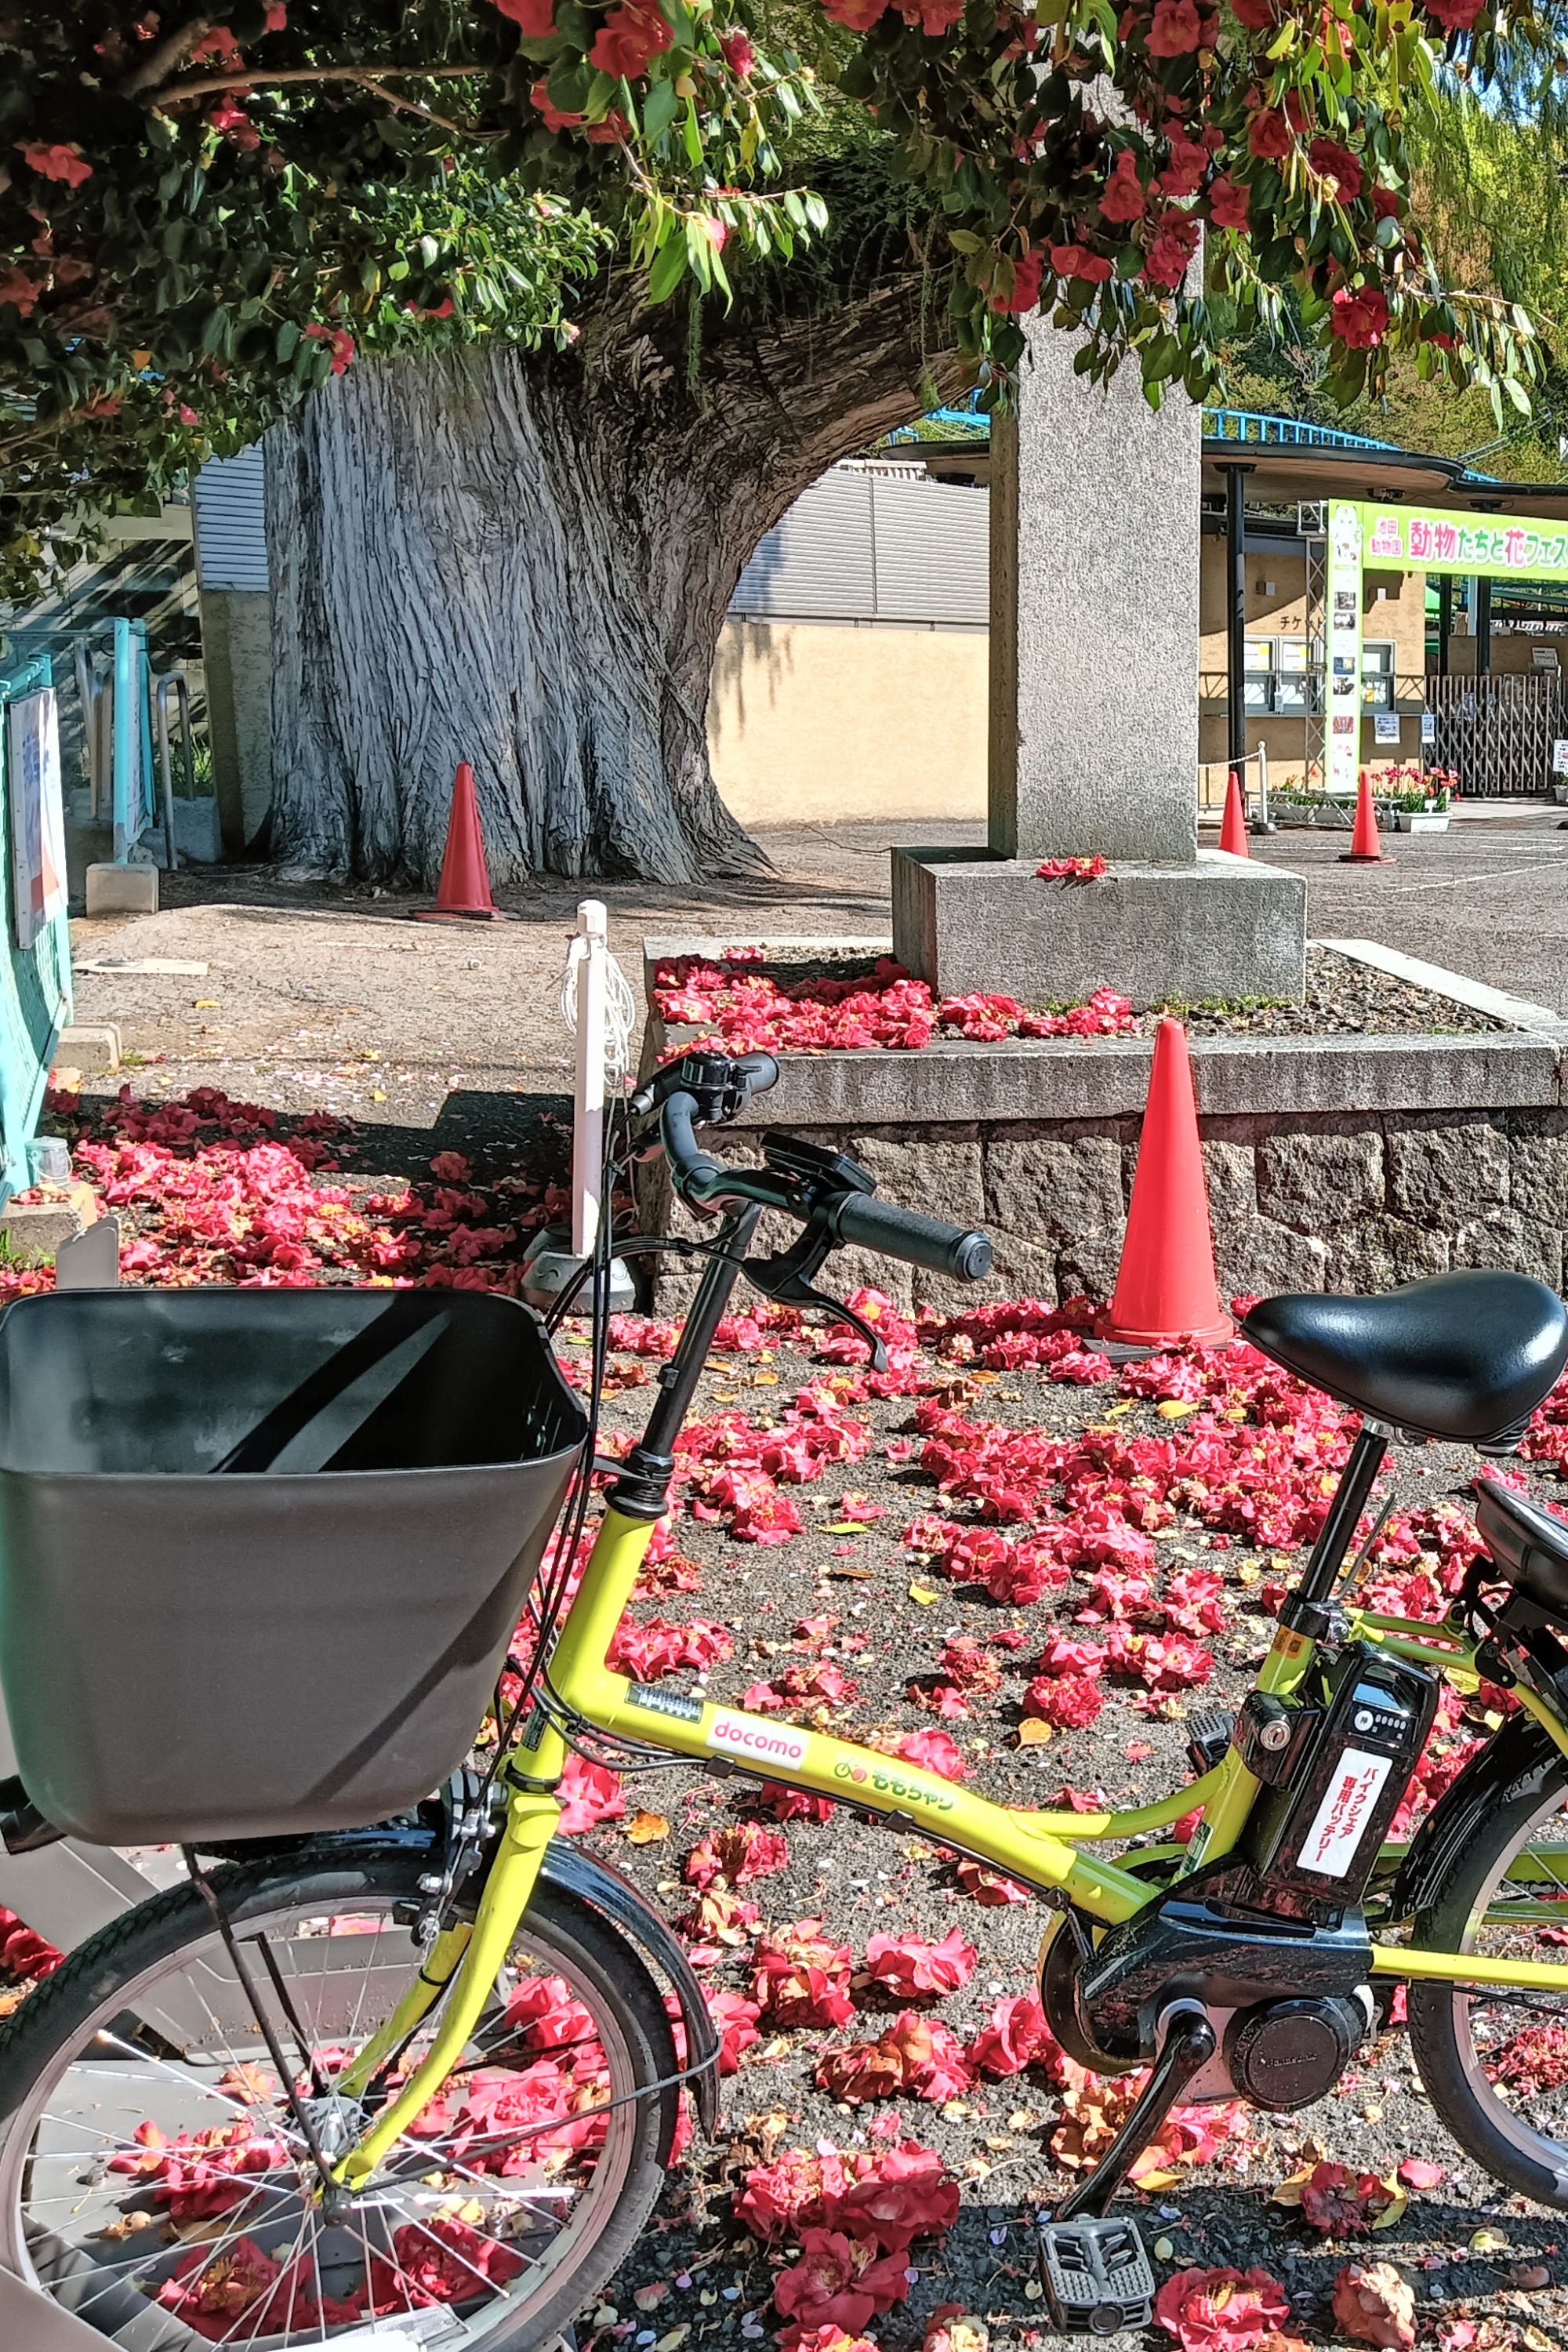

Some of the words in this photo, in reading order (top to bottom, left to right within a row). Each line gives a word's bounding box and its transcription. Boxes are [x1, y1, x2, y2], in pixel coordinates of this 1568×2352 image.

[1371, 538, 1402, 555] 動物園
[1377, 520, 1397, 535] 池田
[714, 1720, 802, 1759] docomo
[872, 1769, 954, 1811] ももちゃり
[1338, 1767, 1379, 1839] バイクシェア
[1315, 1775, 1359, 1862] 専用バッテリー
